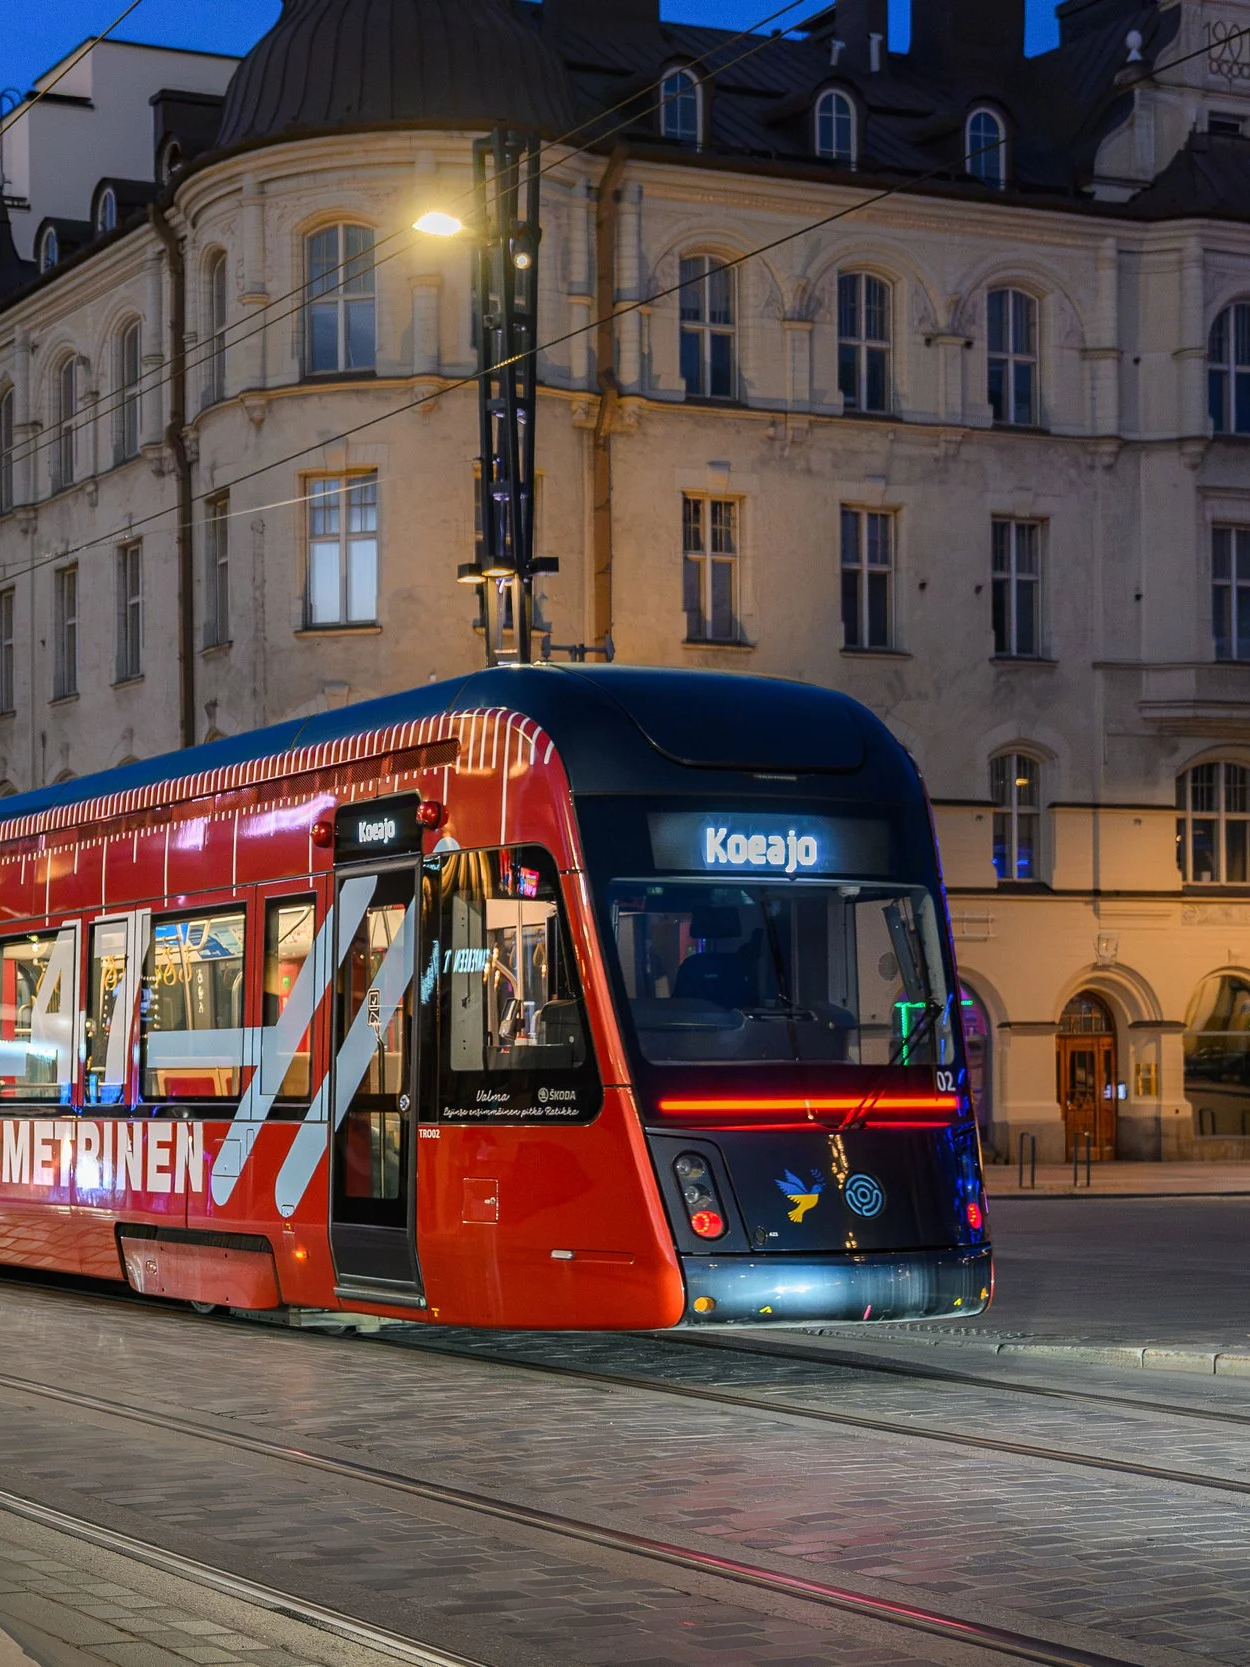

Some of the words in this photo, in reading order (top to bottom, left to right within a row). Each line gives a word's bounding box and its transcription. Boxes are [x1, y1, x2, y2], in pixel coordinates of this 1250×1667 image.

[358, 817, 396, 845] Koeajo
[706, 827, 818, 874] Koeajo
[30, 907, 152, 1085] 47
[936, 1070, 957, 1092] 02
[475, 1089, 510, 1102] Valma
[549, 1088, 577, 1101] ŠKODA
